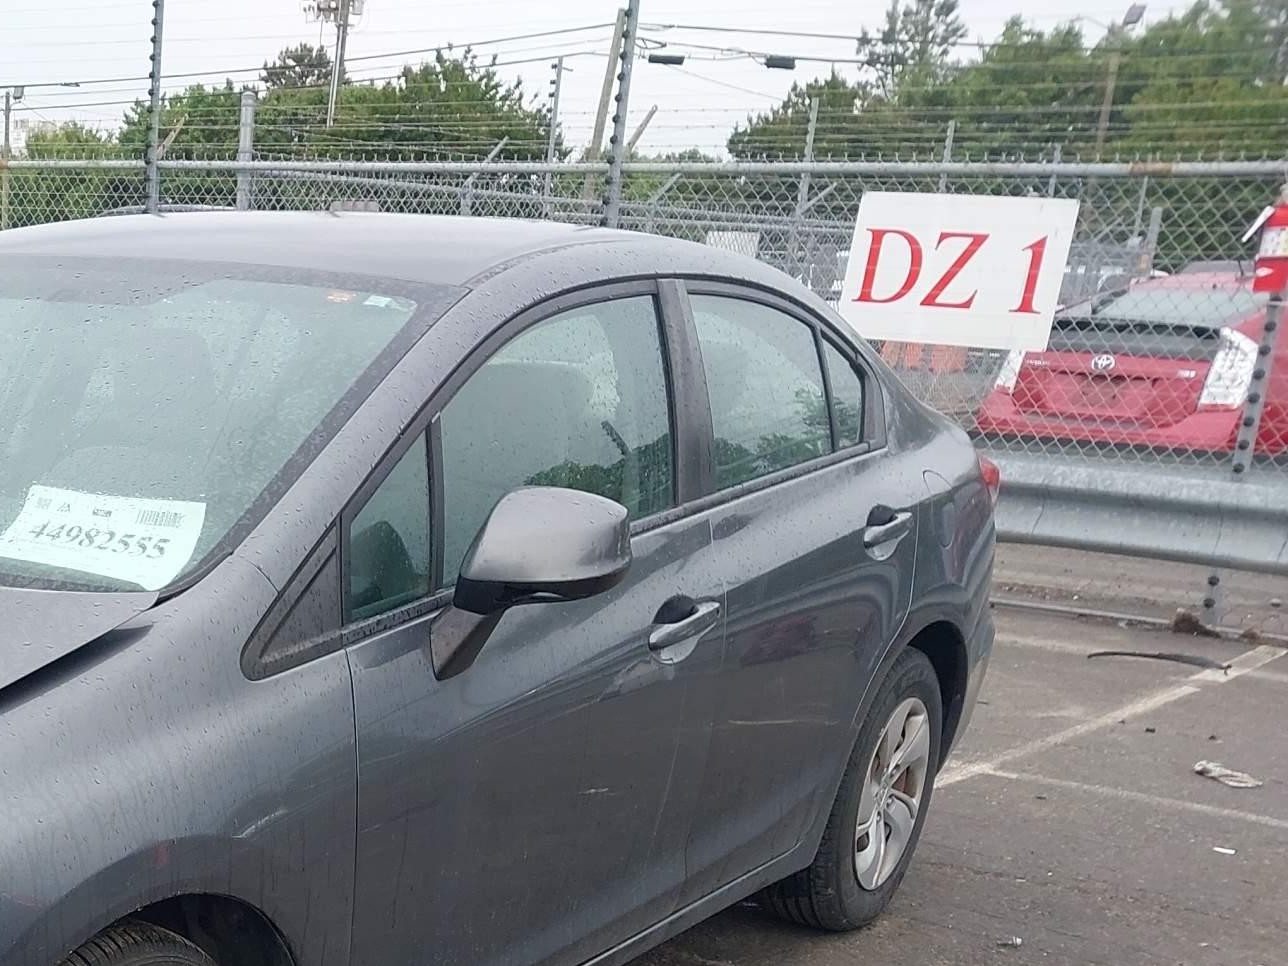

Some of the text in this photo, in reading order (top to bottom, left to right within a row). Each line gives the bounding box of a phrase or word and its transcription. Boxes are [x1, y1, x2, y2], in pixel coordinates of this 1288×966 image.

[851, 227, 1050, 315] DZ 1
[28, 520, 171, 560] 44982555
